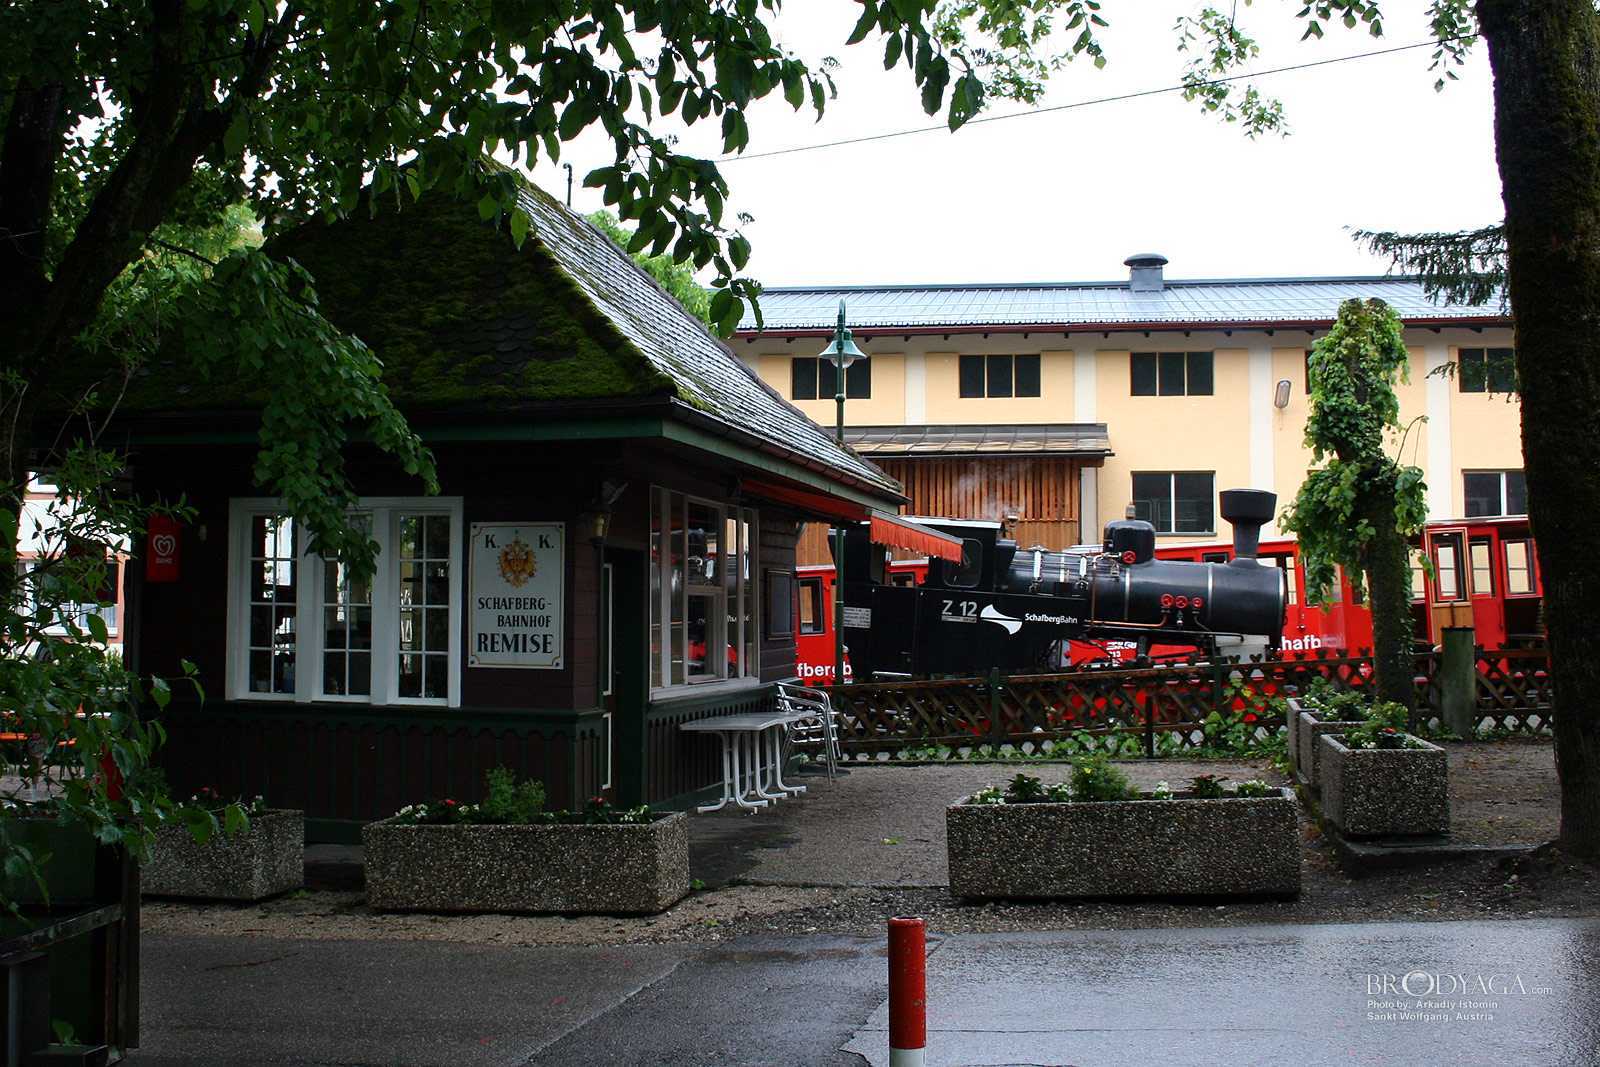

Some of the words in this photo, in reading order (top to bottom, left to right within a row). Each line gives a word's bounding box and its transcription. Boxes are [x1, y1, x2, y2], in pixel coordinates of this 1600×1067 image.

[941, 599, 954, 616] Z
[959, 600, 978, 617] 12
[497, 615, 552, 628] BAHNHOF
[1025, 612, 1078, 625] SchafbergBahn
[477, 632, 554, 654] REMISE
[1277, 634, 1322, 651] hafb
